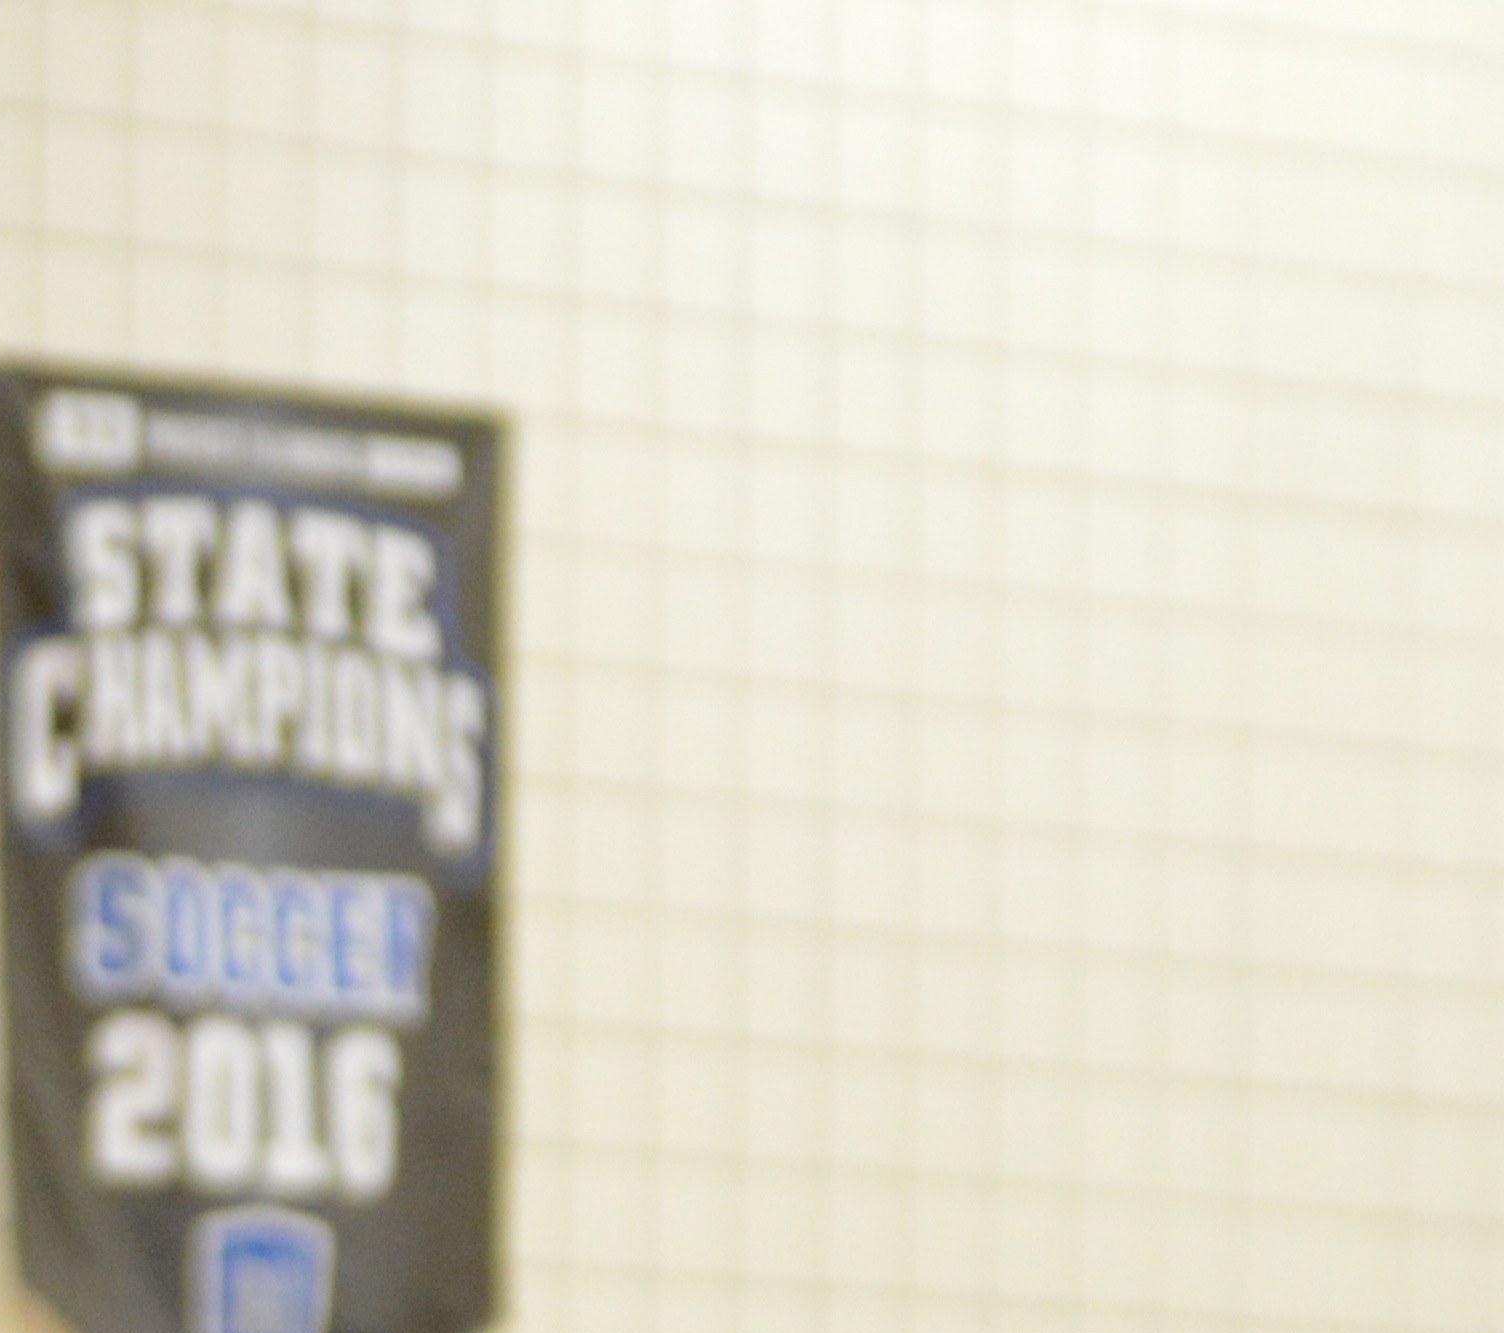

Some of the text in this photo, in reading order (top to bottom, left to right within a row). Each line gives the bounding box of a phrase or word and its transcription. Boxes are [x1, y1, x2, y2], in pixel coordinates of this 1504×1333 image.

[66, 495, 443, 664] STATE
[11, 626, 486, 854] CHAMPIONS
[65, 851, 437, 1030] SOCCER
[86, 1011, 403, 1204] 2016
